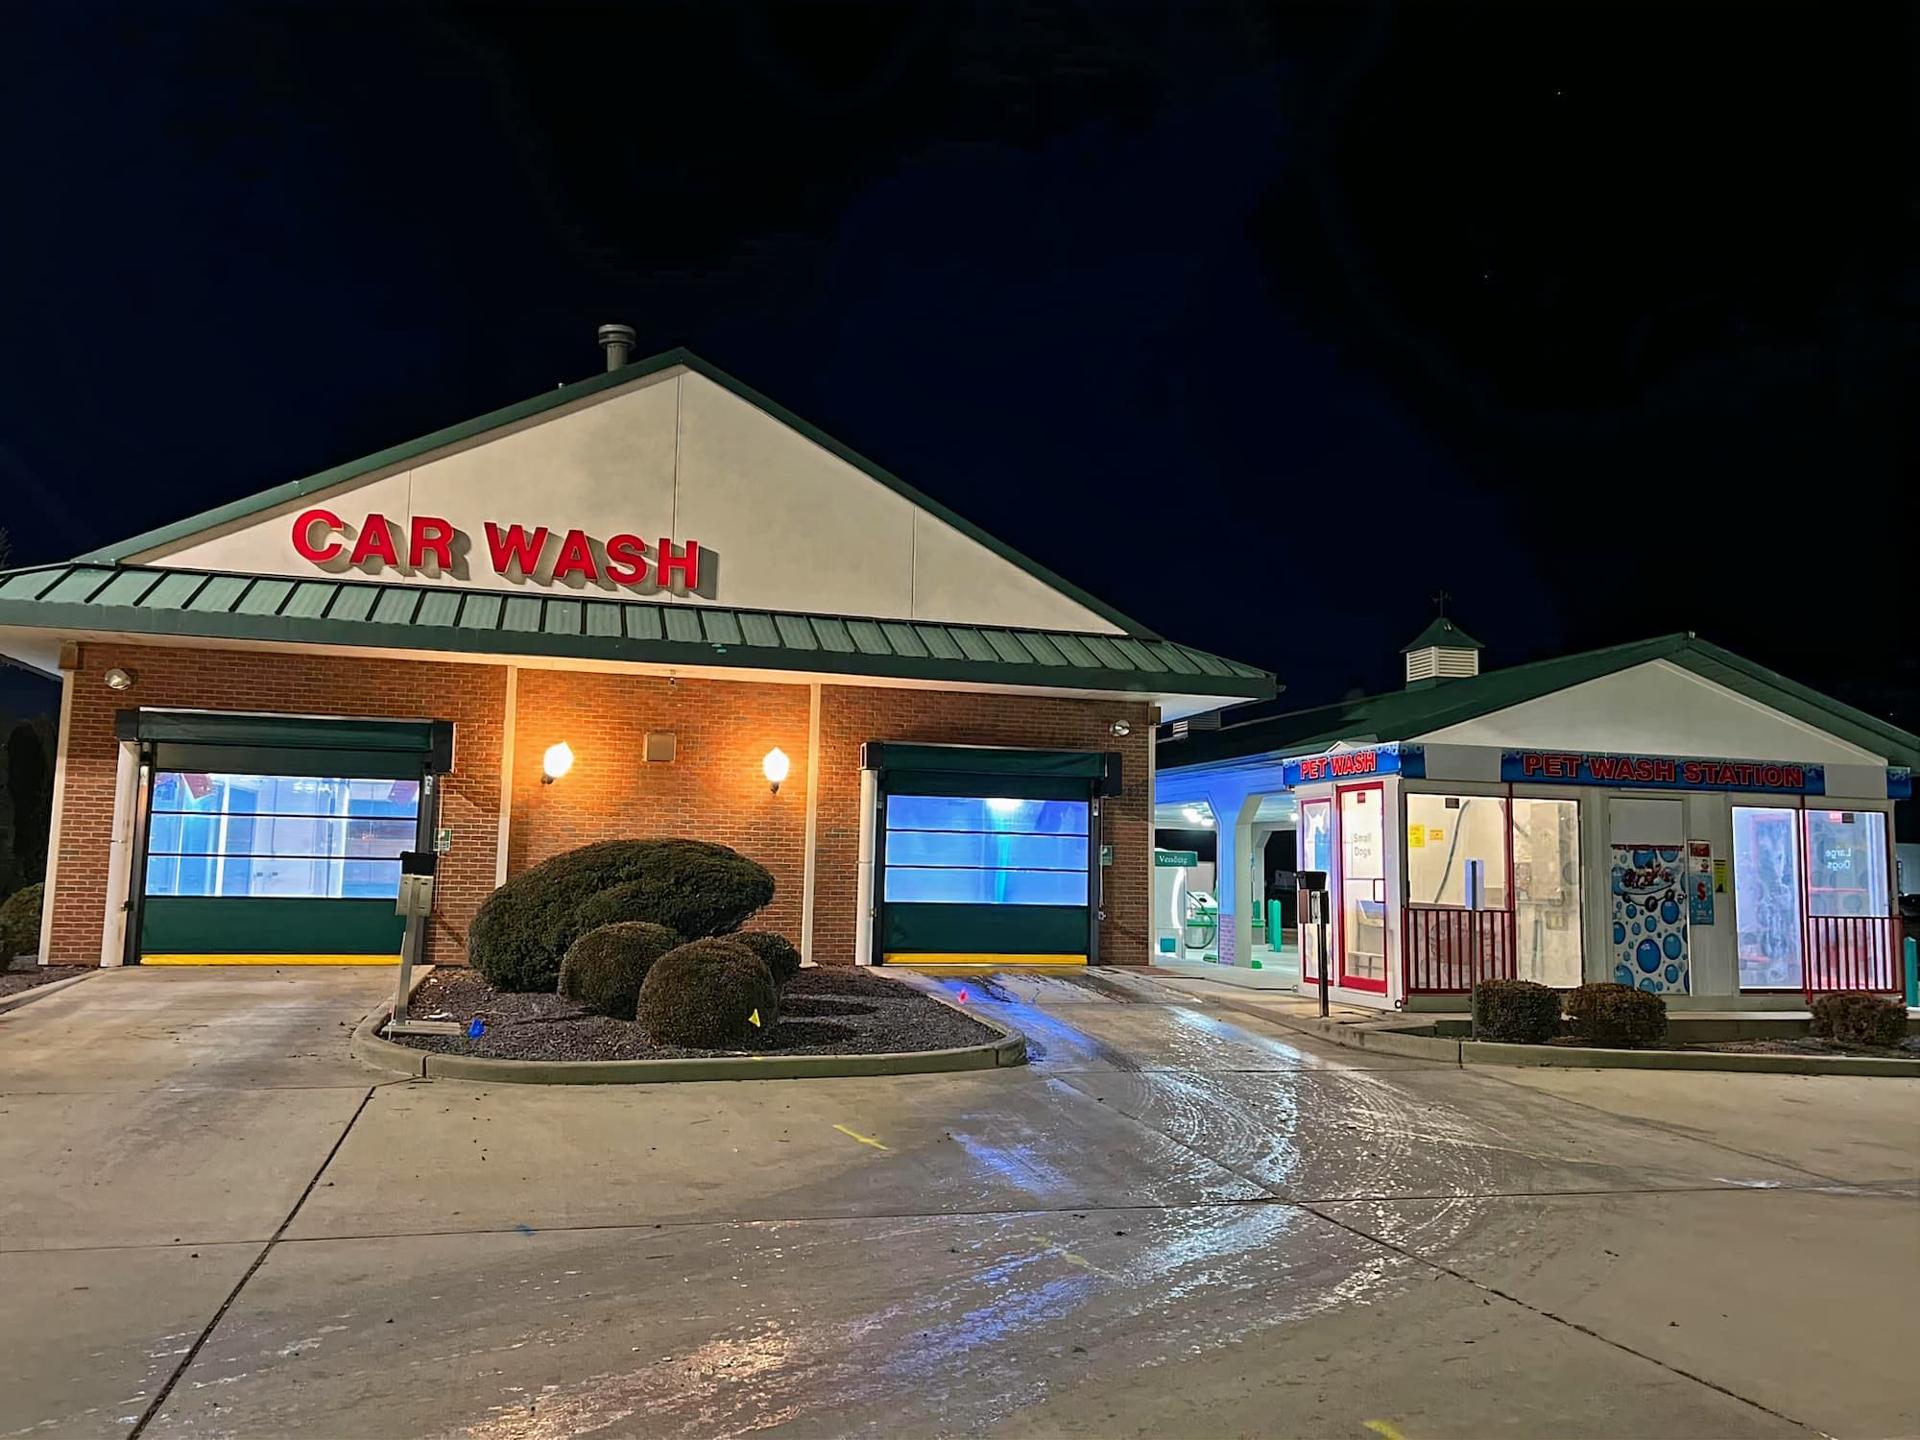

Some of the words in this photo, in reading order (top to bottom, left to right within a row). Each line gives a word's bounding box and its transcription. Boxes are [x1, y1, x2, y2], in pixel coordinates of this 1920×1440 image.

[292, 509, 454, 570] CAR
[484, 521, 699, 589] WASH
[1300, 758, 1327, 780] PET
[1330, 751, 1376, 776] WASH
[1523, 753, 1582, 778] PET
[1588, 755, 1676, 782] WASH
[1683, 761, 1803, 788] STATION
[1353, 833, 1372, 843] Small
[1159, 855, 1188, 865] Vending
[1354, 846, 1371, 858] Dogs
